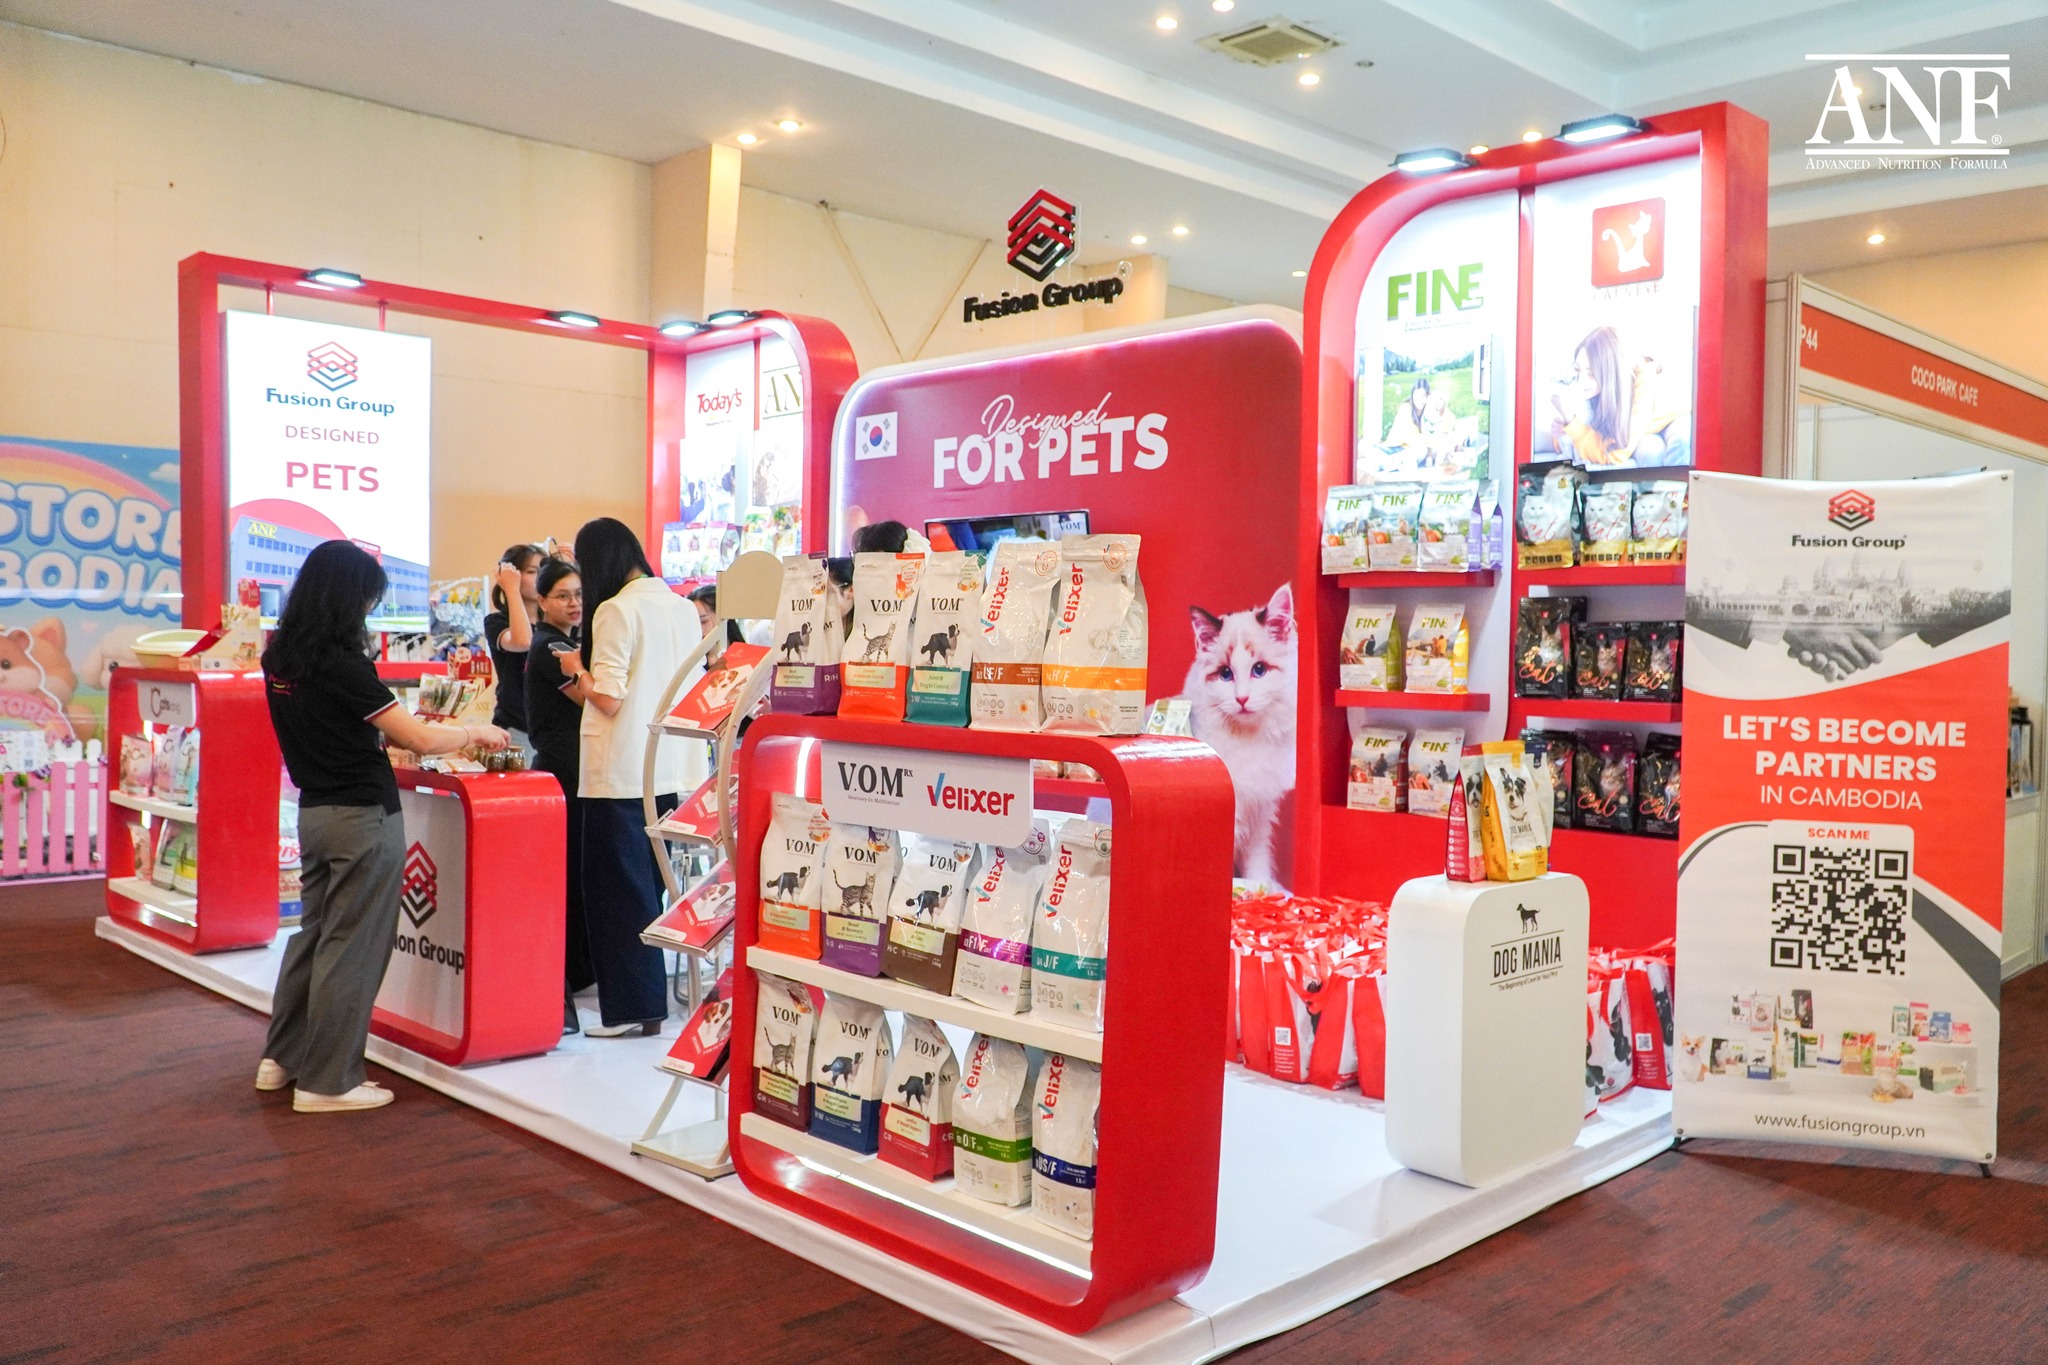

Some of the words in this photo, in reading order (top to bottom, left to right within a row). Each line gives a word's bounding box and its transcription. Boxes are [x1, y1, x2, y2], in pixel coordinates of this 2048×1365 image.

[964, 292, 1039, 322] Fusion
[1042, 277, 1124, 307] Group
[1387, 262, 1484, 321] FINE
[1911, 365, 1935, 391] COCO
[1936, 376, 1957, 399] PARK
[1959, 383, 1979, 407] CAFE
[266, 388, 331, 407] Fusion
[336, 396, 395, 416] Group
[697, 388, 742, 414] Today's
[286, 425, 379, 444] DESIGNED
[980, 392, 1112, 450] Designed
[933, 432, 1025, 488] FOR
[1038, 413, 1169, 480] PETS
[286, 461, 379, 492] PETS
[1337, 499, 1362, 510] FINE
[1382, 495, 1408, 506] FINE
[248, 521, 277, 539] ANF
[1792, 535, 1848, 548] Fusion
[1851, 536, 1906, 550] Group
[980, 567, 1010, 634] Velixer
[1057, 563, 1083, 635] Velixer
[1355, 617, 1381, 628] FINE
[1421, 617, 1449, 628] FINE
[1364, 737, 1390, 748] FINE
[1723, 715, 1811, 742] LET'S
[1818, 718, 1967, 748] BECOME
[1422, 742, 1450, 752] FINE
[1755, 751, 1937, 782] PARTNERS
[927, 773, 1015, 817] Velixer
[1761, 785, 1783, 804] IN
[1789, 786, 1923, 811] CAMBODIA
[1808, 828, 1846, 840] SCAN
[1850, 830, 1870, 841] ME
[1042, 845, 1073, 918] Velixer
[419, 935, 465, 975] Group
[1494, 947, 1517, 978] DOG
[1522, 936, 1562, 971] MANIA
[1754, 1113, 1926, 1140] www.fusiongroup.vn
